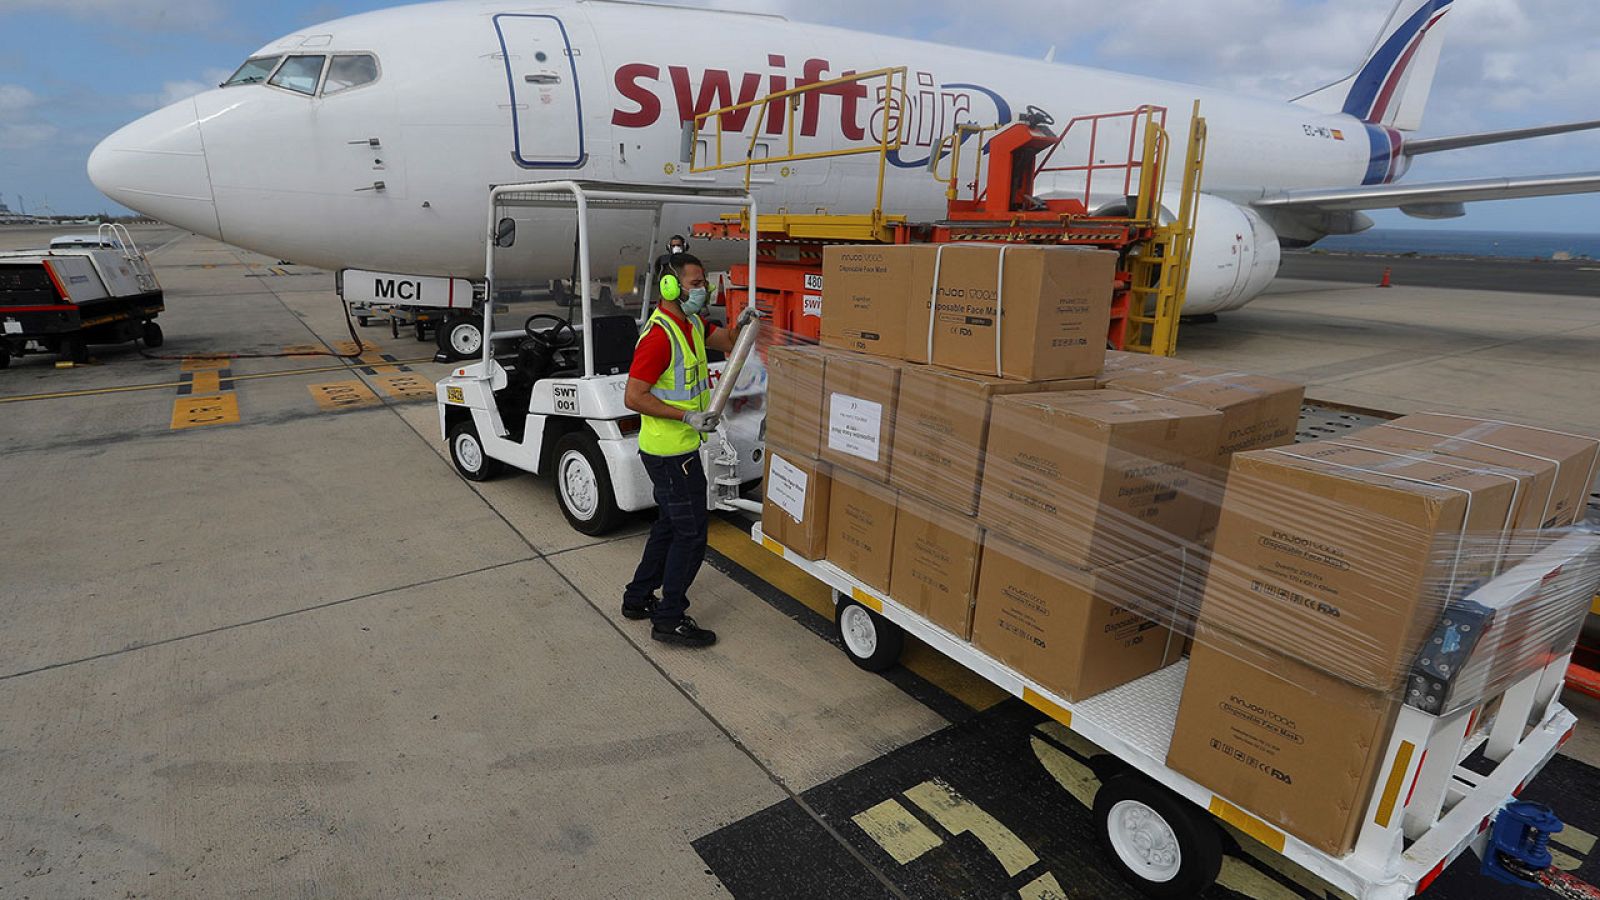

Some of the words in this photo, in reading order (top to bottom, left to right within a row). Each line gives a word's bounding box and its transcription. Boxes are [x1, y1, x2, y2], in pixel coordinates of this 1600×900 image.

[375, 279, 421, 300] MCI
[967, 305, 984, 314] Face
[555, 388, 576, 397] SWT
[557, 400, 575, 410] 001
[1317, 601, 1340, 617] FDA
[1224, 703, 1260, 724] Disposable
[1271, 768, 1292, 785] FDA
